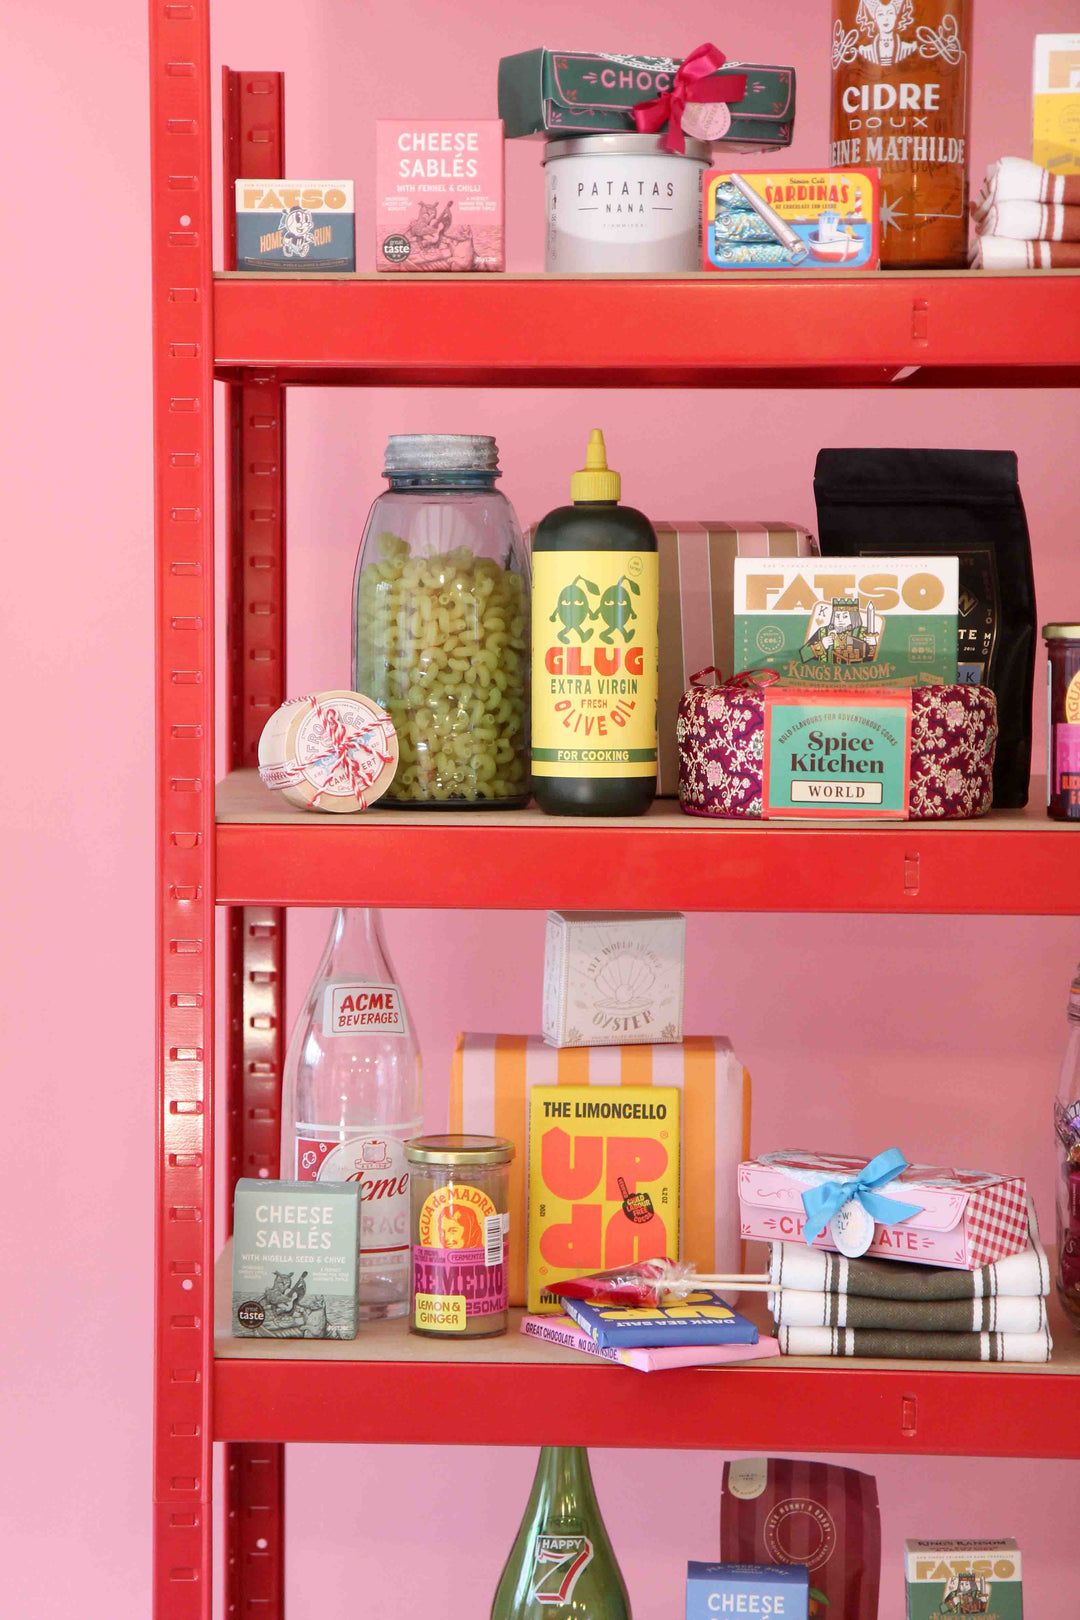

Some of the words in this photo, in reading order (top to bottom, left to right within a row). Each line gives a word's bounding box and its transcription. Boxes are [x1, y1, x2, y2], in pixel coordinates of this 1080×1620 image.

[842, 83, 940, 113] CIDRE
[849, 117, 928, 130] DOUX
[397, 132, 479, 151] CHEESE
[866, 136, 965, 163] MATHILDE
[398, 153, 478, 178] SABLÉS
[243, 189, 347, 209] FATSO
[577, 181, 674, 197] PATATAS
[765, 184, 849, 204] SARDINAS
[606, 204, 644, 213] NANA
[260, 230, 283, 253] HOME
[314, 225, 332, 247] RUN
[384, 244, 410, 254] taste
[746, 572, 945, 611] FATSO
[818, 605, 829, 618] K
[545, 647, 644, 676] GLUG
[787, 660, 833, 680] KING'S
[834, 661, 891, 683] RANSOM
[551, 678, 591, 695] EXTRA
[598, 678, 638, 695] VIRGIN
[581, 699, 608, 709] FRESH
[554, 699, 608, 736] OLIVE
[611, 700, 636, 728] OIL
[778, 730, 793, 744] BOLD
[792, 715, 823, 732] FLAVOURS
[838, 714, 881, 732] ADVENTUROUS
[880, 729, 898, 746] COOKS
[808, 731, 874, 755] Spice
[557, 751, 580, 761] FOR
[581, 750, 629, 762] COOKING
[790, 753, 884, 773] Kitchen
[808, 786, 866, 798] WORLD
[340, 993, 394, 1013] ACME
[338, 1012, 399, 1027] BEVERAGES
[592, 1010, 654, 1031] OYSTER
[543, 1101, 571, 1117] THE
[575, 1102, 667, 1119] LIMONCELLO
[541, 1126, 669, 1201] UP
[255, 1205, 334, 1224] CHEESE
[422, 1205, 435, 1246] AGUA
[432, 1193, 447, 1208] de
[447, 1187, 494, 1219] MADRE
[255, 1226, 332, 1249] SABLÉS
[262, 1255, 294, 1263] NIGELLA
[323, 1256, 346, 1264] CHIVE
[452, 1252, 485, 1260] FERMENTE
[414, 1263, 503, 1299] REMEDIO
[239, 1311, 264, 1320] taste
[418, 1299, 450, 1312] LEMON
[452, 1302, 461, 1312] &
[420, 1312, 459, 1324] GINGER
[526, 1322, 543, 1336] GREAT
[579, 1338, 587, 1350] NO
[542, 1540, 583, 1549] HAPPY
[534, 1535, 594, 1604] 7
[916, 1560, 1015, 1580] FATSO
[708, 1593, 785, 1614] CHEESE
